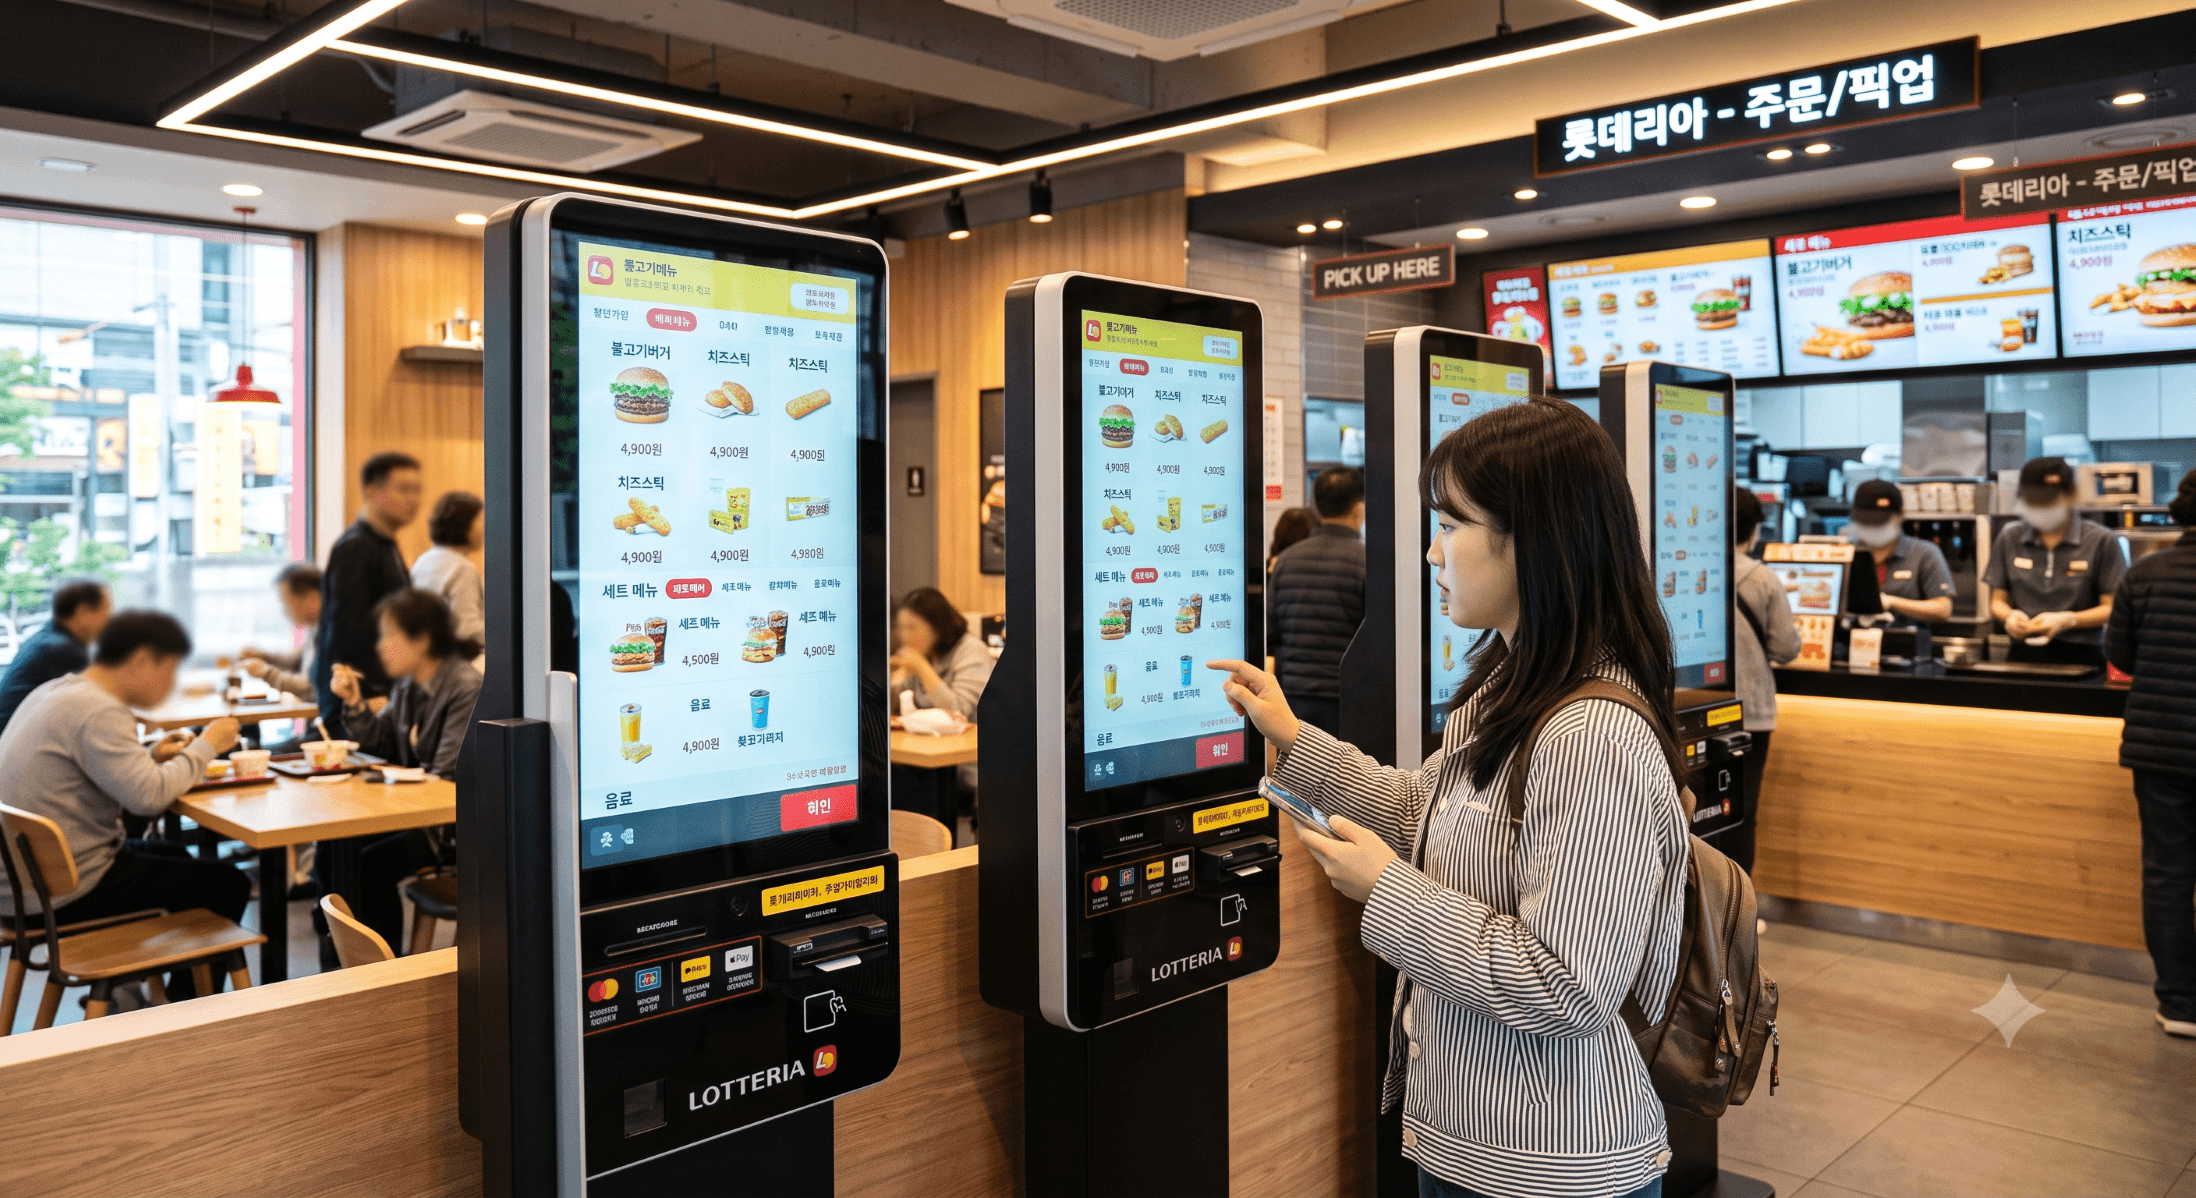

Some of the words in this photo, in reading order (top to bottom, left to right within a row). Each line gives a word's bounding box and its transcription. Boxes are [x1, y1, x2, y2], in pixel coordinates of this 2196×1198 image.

[1562, 97, 1708, 162] 롯데리아
[1716, 107, 1736, 120] -
[1744, 54, 1934, 129] 주문/픽업
[1979, 173, 2070, 208] 롯데리아
[2068, 223, 2131, 244] 치즈스틱
[1323, 266, 1363, 290] PICK
[1366, 263, 1391, 283] UP
[1393, 256, 1441, 280] HERE
[611, 341, 671, 360] 불고기버거
[708, 349, 750, 367] 치즈스틱
[789, 356, 828, 373] 치즈스틱
[618, 475, 664, 491] 치즈스틱
[1104, 488, 1131, 500] 치즈스틱
[1094, 571, 1110, 583] 세트
[602, 583, 628, 599] 세트
[632, 583, 658, 599] 메뉴
[682, 652, 719, 667] 4,500원
[690, 698, 711, 712] 음료
[682, 737, 720, 754] 4,900원
[604, 791, 633, 810] 음료
[735, 952, 750, 963] Pay
[1151, 947, 1223, 982] LOTTERIA
[689, 1060, 806, 1111] LOTTERIA
